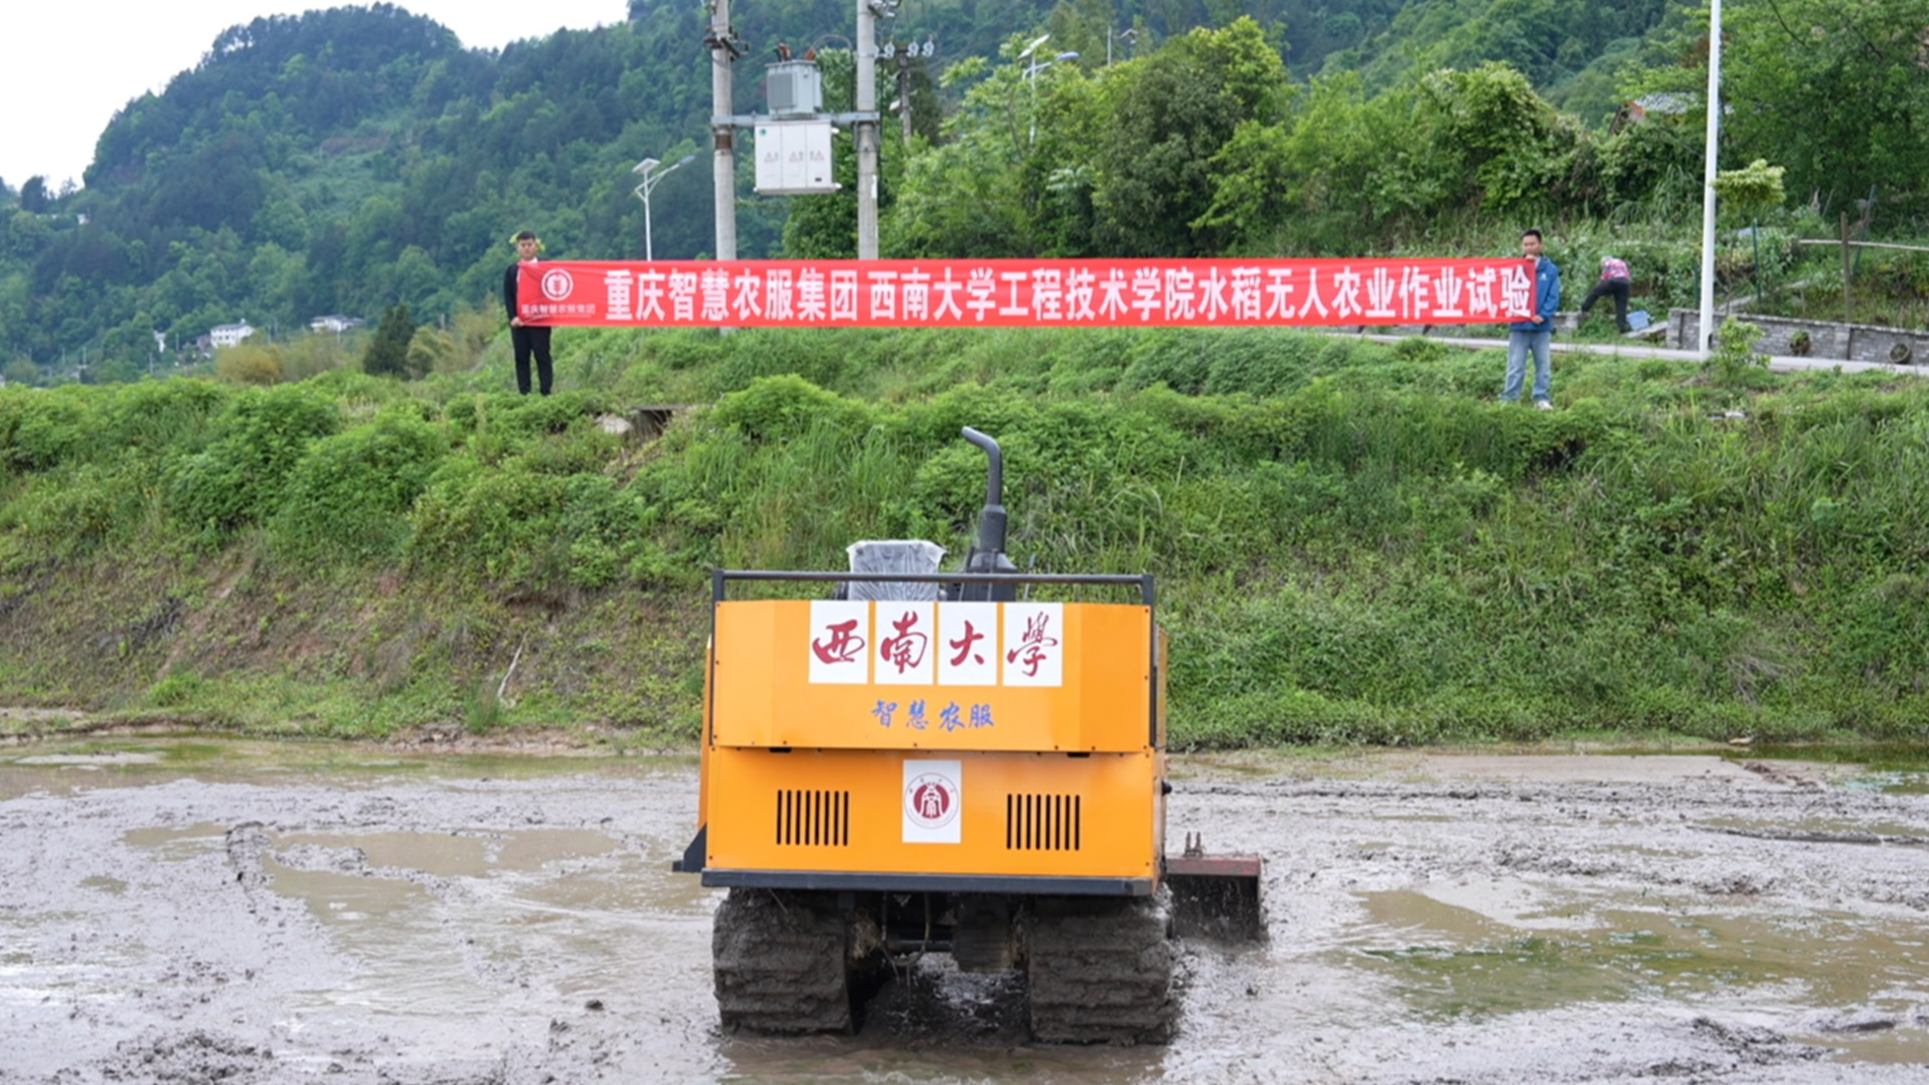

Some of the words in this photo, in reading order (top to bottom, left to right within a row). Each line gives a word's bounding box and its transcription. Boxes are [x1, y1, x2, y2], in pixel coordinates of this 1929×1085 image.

[604, 267, 858, 321] 重庆智慧农服集团
[868, 266, 1532, 321] 西南大学工程技术学院水稻无人农业作业试验
[871, 699, 995, 732] 智慧农服
